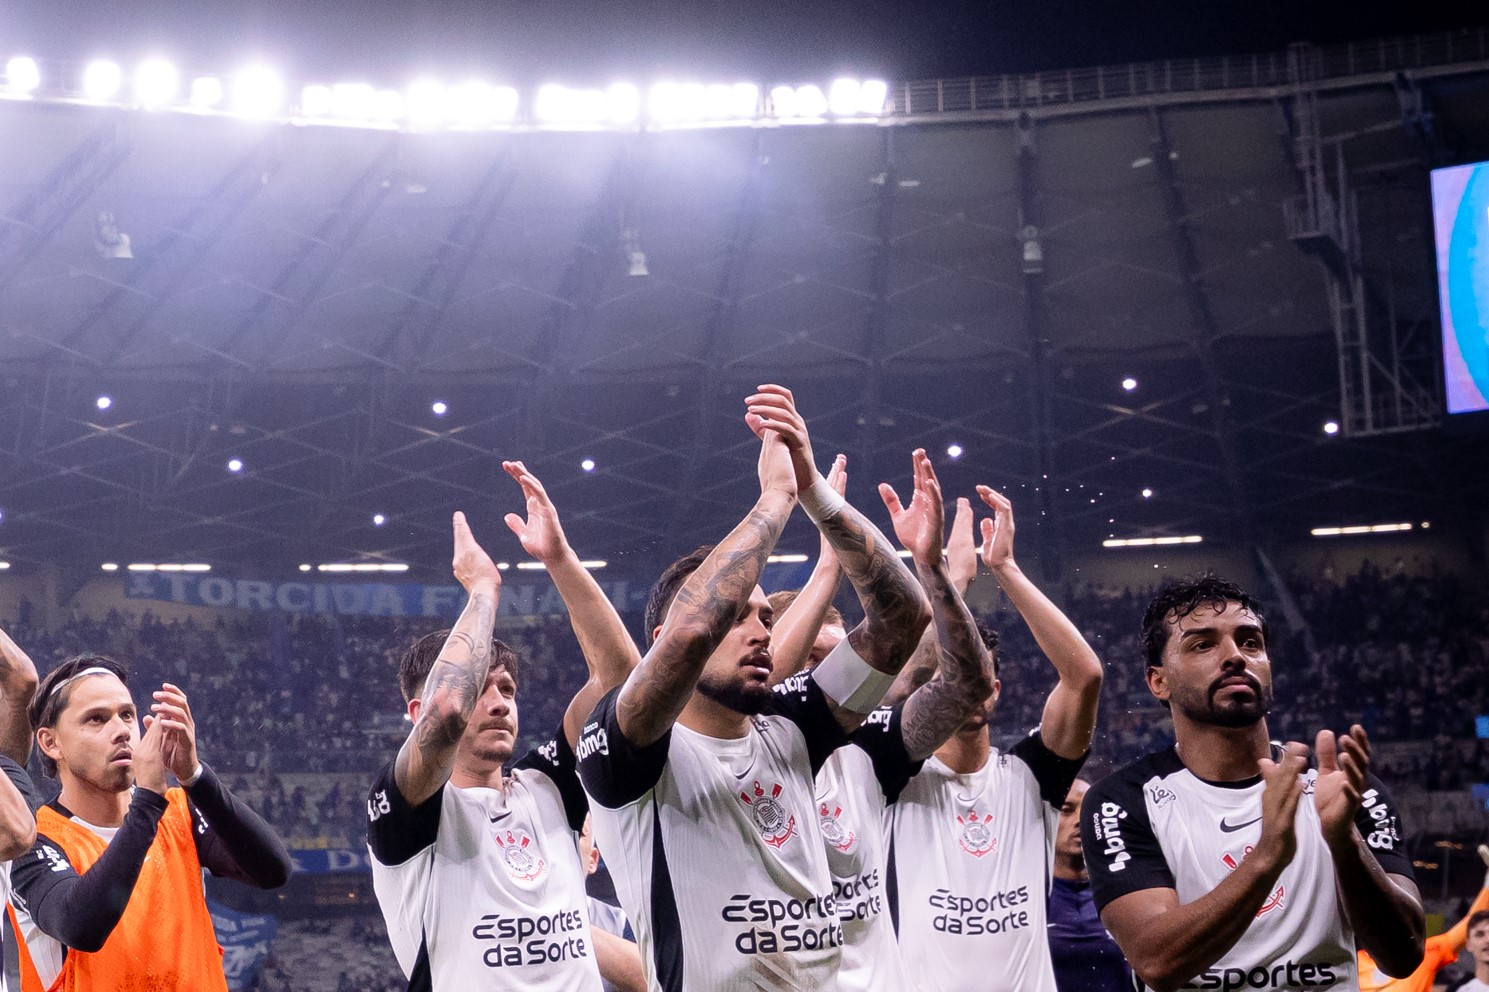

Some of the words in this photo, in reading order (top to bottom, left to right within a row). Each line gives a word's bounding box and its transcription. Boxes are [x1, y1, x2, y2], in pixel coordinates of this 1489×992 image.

[158, 573, 408, 617] TORCIDA
[1092, 812, 1102, 840] banco
[1101, 801, 1128, 856] bmg
[721, 893, 837, 929] Esporte
[928, 885, 1029, 917] Esportes
[472, 907, 583, 943] Esportes
[932, 913, 963, 936] da
[966, 908, 1030, 936] Sorte
[482, 943, 523, 968] da
[526, 936, 588, 966] Sorte
[735, 926, 778, 955] da
